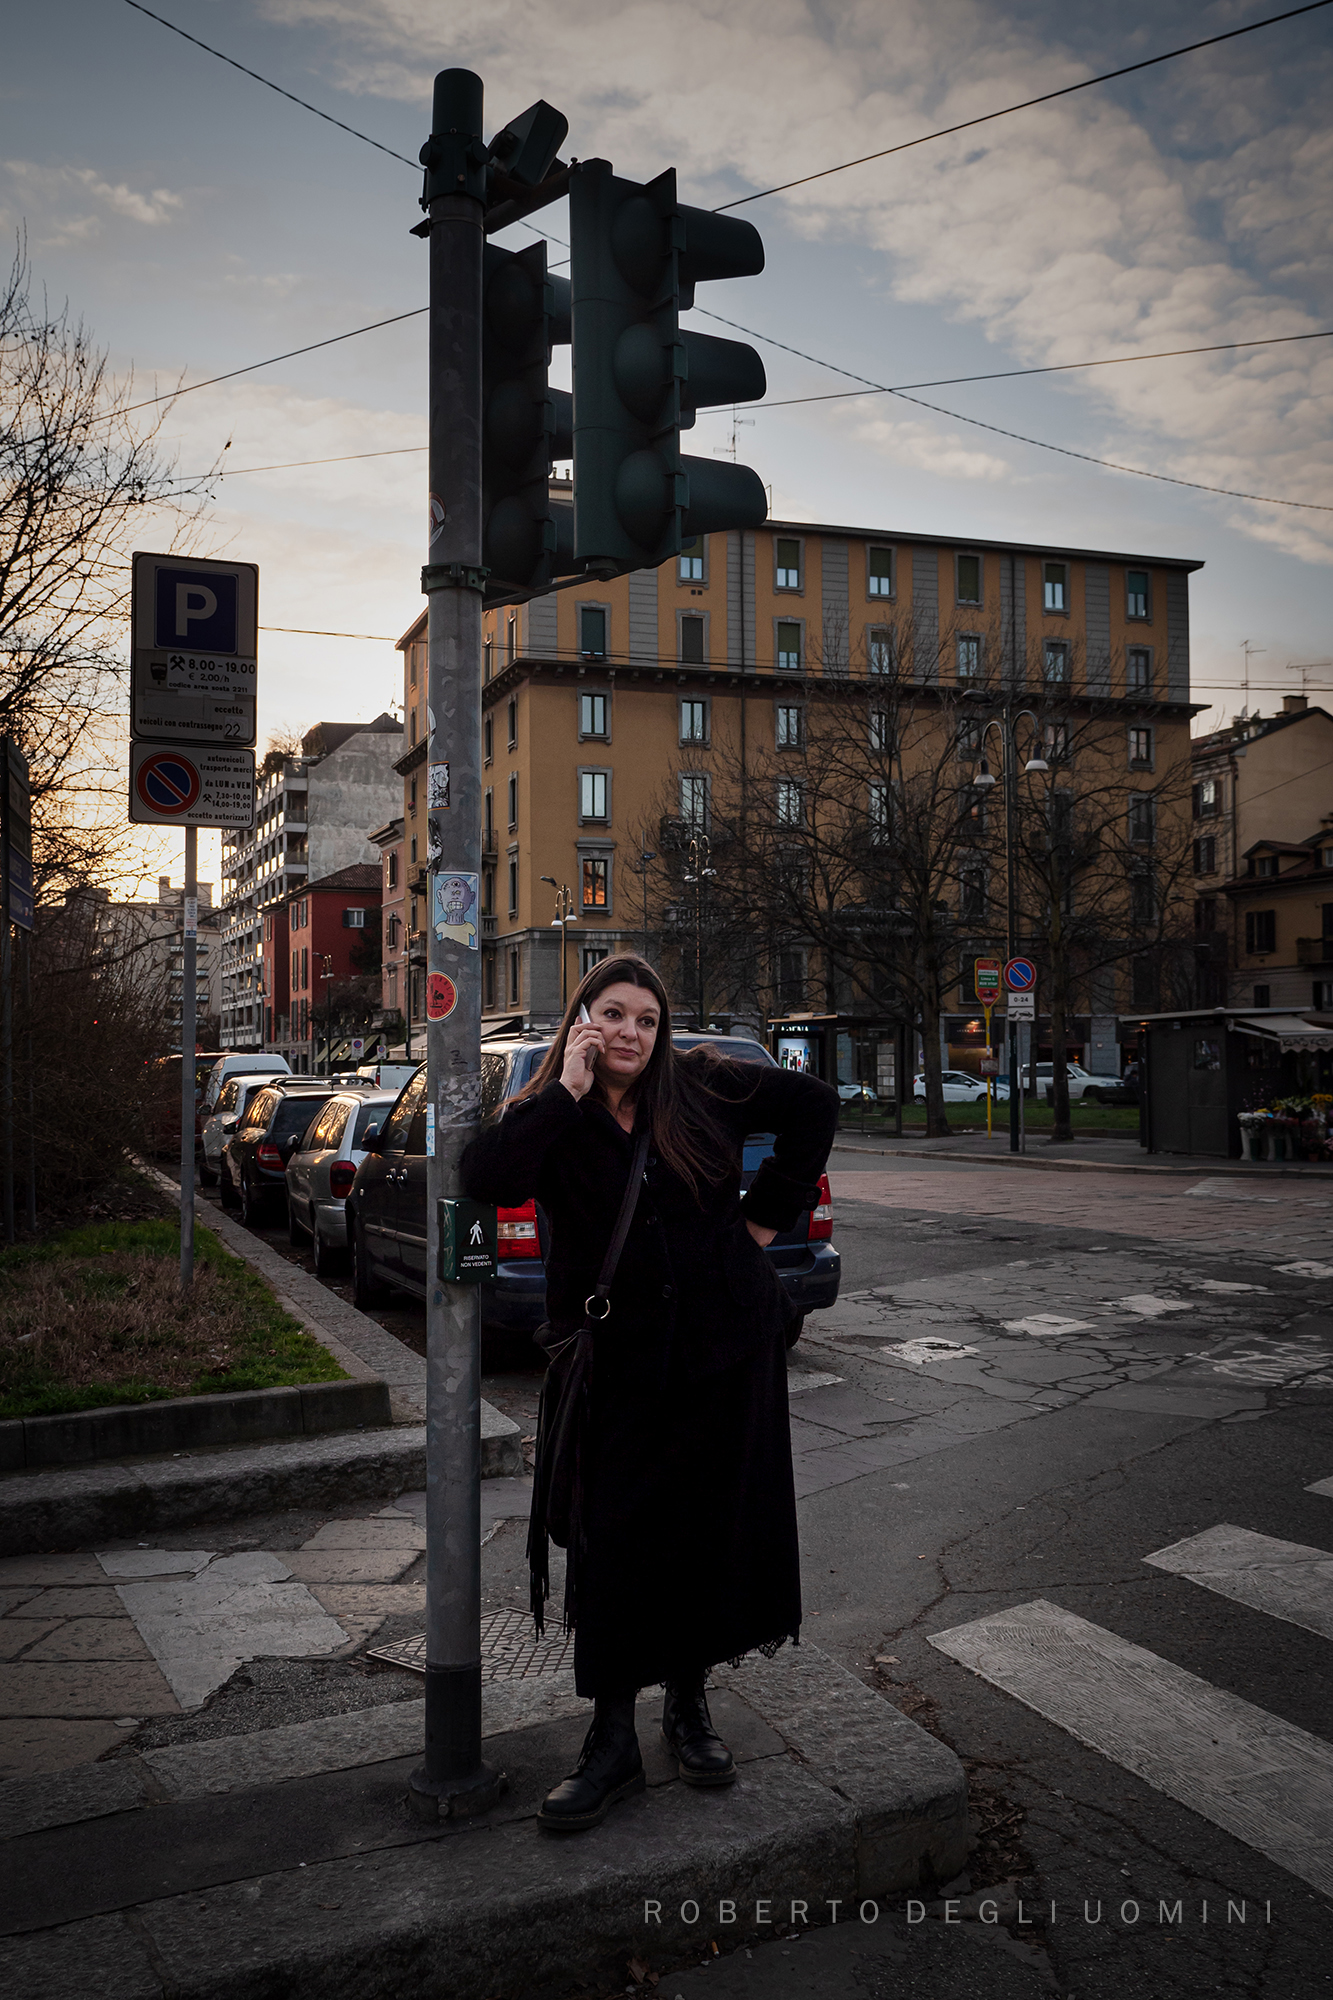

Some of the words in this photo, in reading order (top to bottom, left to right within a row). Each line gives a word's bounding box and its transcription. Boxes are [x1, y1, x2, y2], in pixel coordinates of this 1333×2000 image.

[175, 582, 217, 637] P
[188, 672, 195, 681] €
[214, 706, 243, 715] eccetto
[139, 717, 163, 726] veicoli
[164, 719, 177, 727] con
[178, 720, 223, 732] contrassegno
[224, 723, 241, 737] 22
[207, 755, 245, 764] autoveicoli
[200, 763, 231, 773] trasporto
[233, 766, 252, 774] merci
[204, 779, 213, 787] da
[215, 780, 230, 788] LUN
[236, 781, 251, 790] VEN
[187, 812, 213, 820] eccetto
[214, 813, 250, 822] autorizzati
